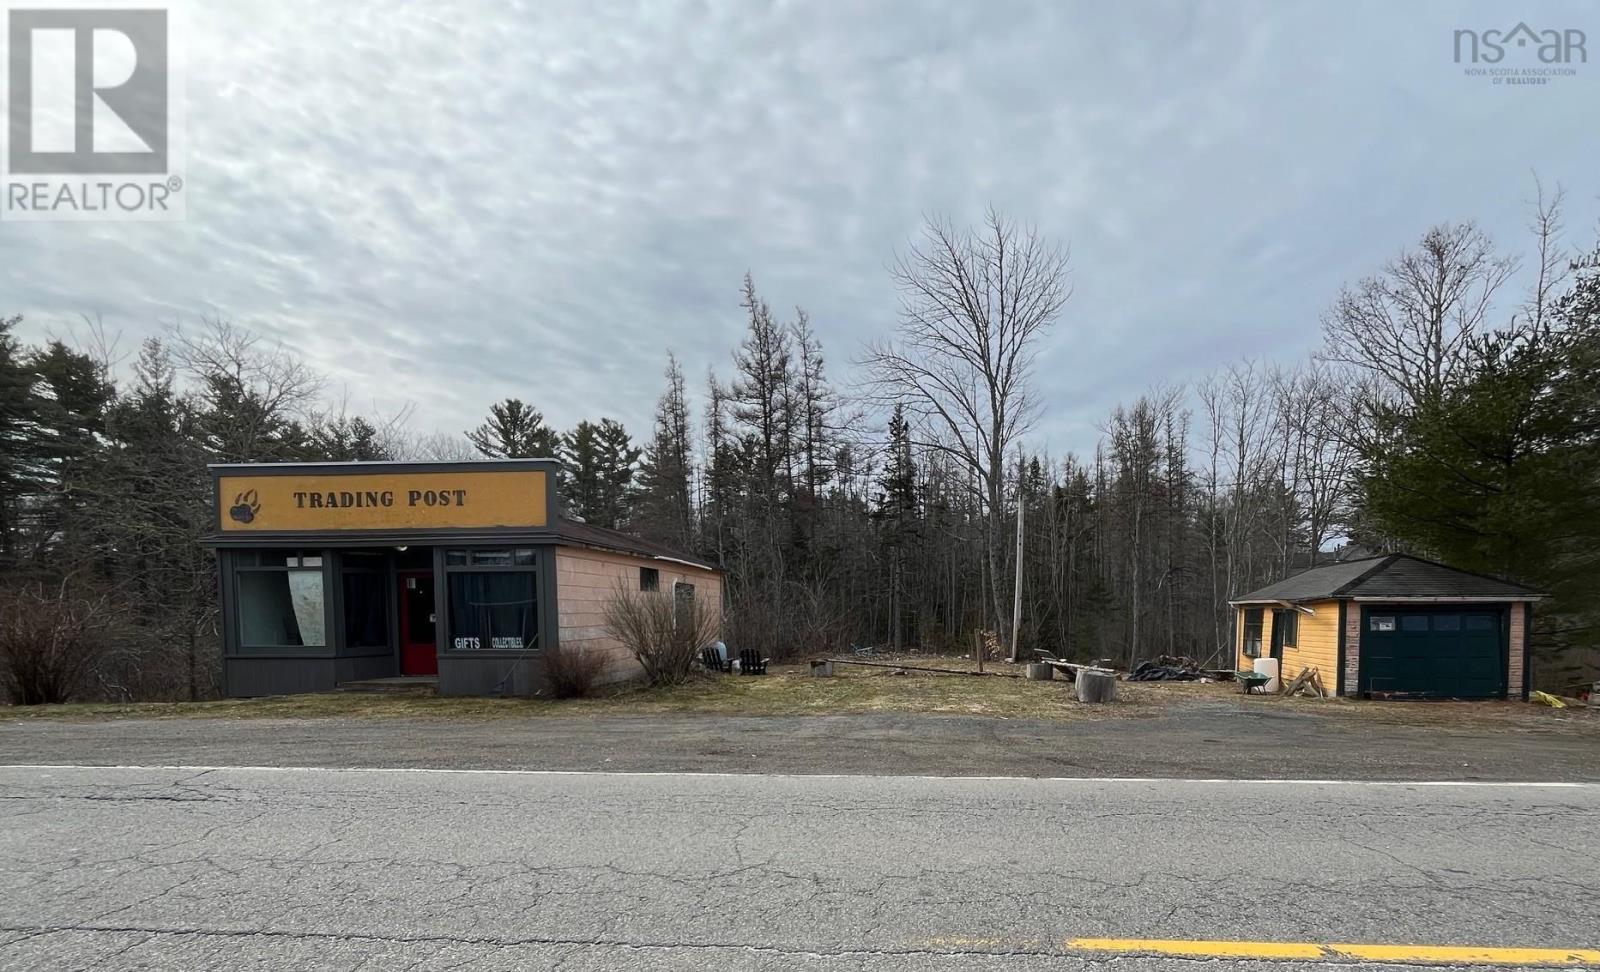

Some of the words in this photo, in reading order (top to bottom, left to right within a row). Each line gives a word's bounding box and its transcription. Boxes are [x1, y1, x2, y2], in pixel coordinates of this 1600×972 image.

[293, 491, 393, 508] TRADING
[408, 490, 466, 506] POST
[454, 637, 481, 649] GIFTS
